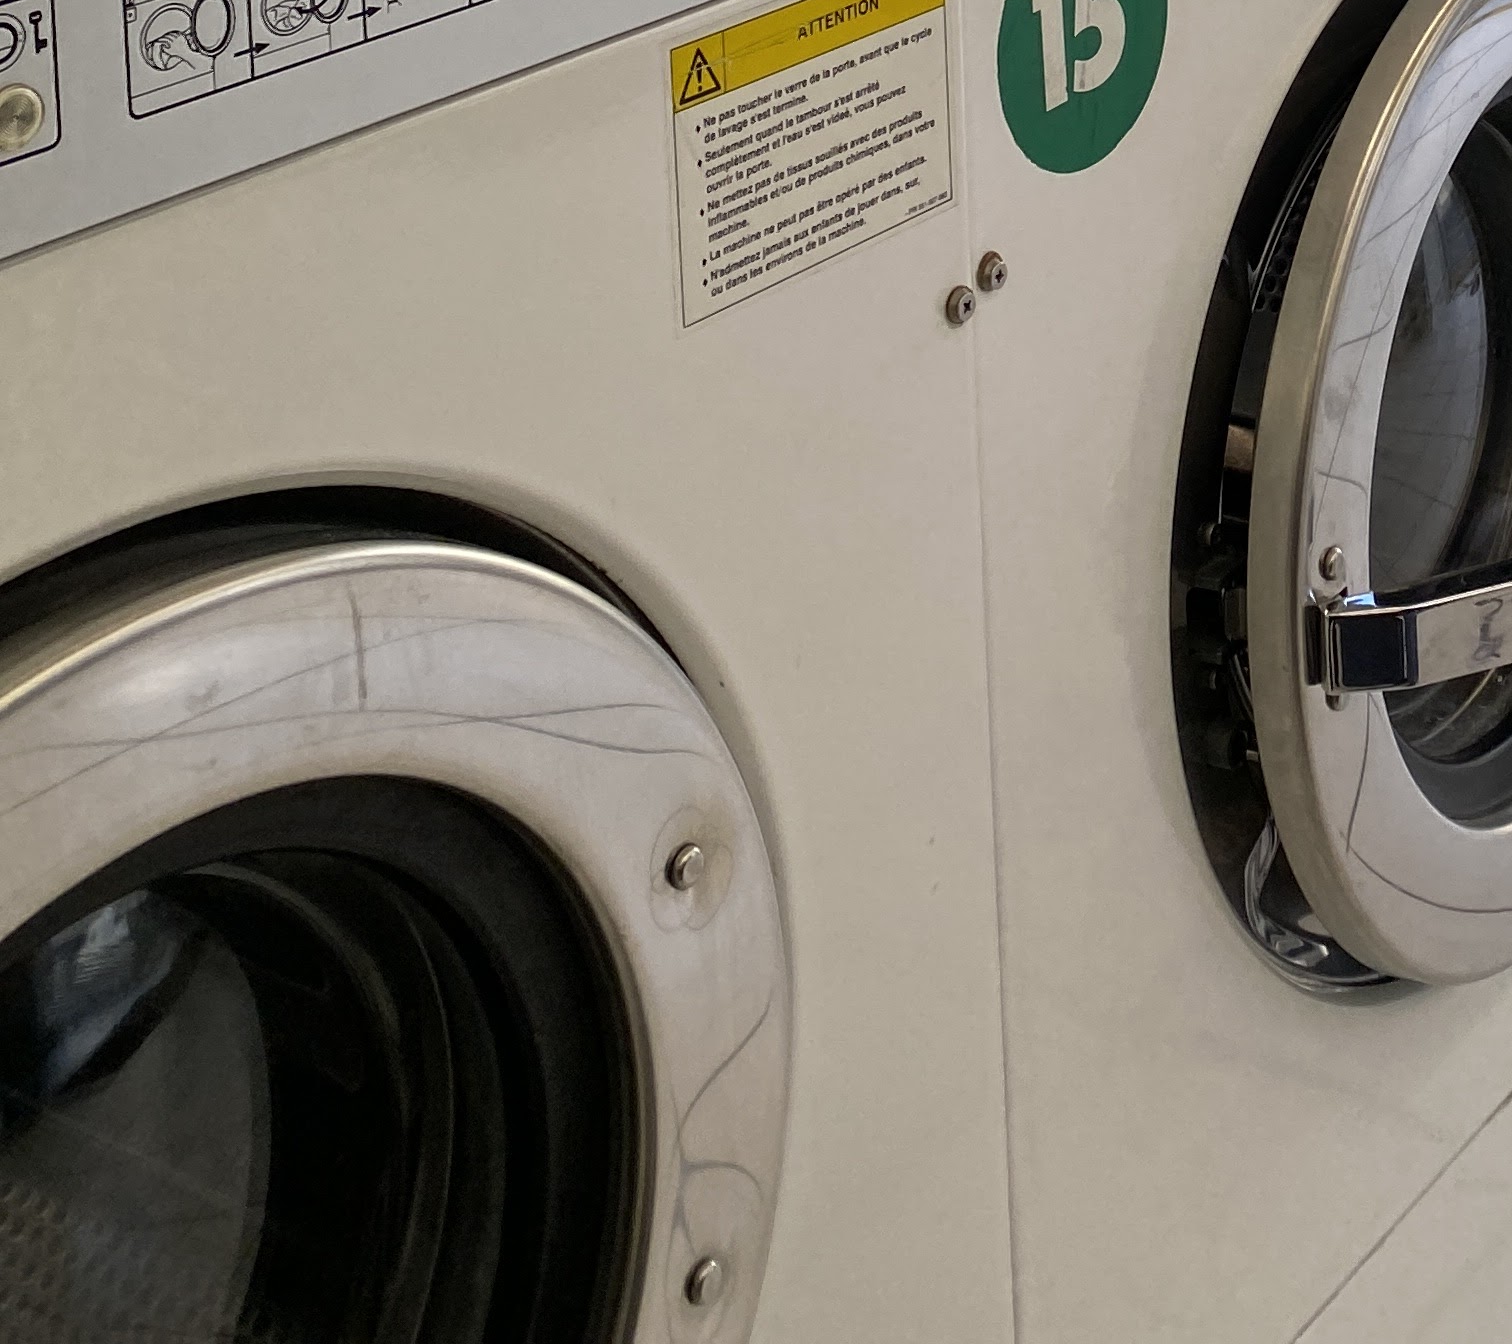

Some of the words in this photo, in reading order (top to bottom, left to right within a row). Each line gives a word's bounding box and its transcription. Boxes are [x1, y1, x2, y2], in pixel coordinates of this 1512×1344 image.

[703, 116, 717, 129] Ne
[718, 107, 735, 124] pas
[738, 93, 773, 115] toucher
[774, 87, 783, 99] le
[785, 79, 808, 94] verre
[809, 74, 820, 85] de
[822, 68, 830, 79] la
[884, 41, 899, 56] que
[901, 35, 909, 47] le
[911, 27, 932, 44] cycle
